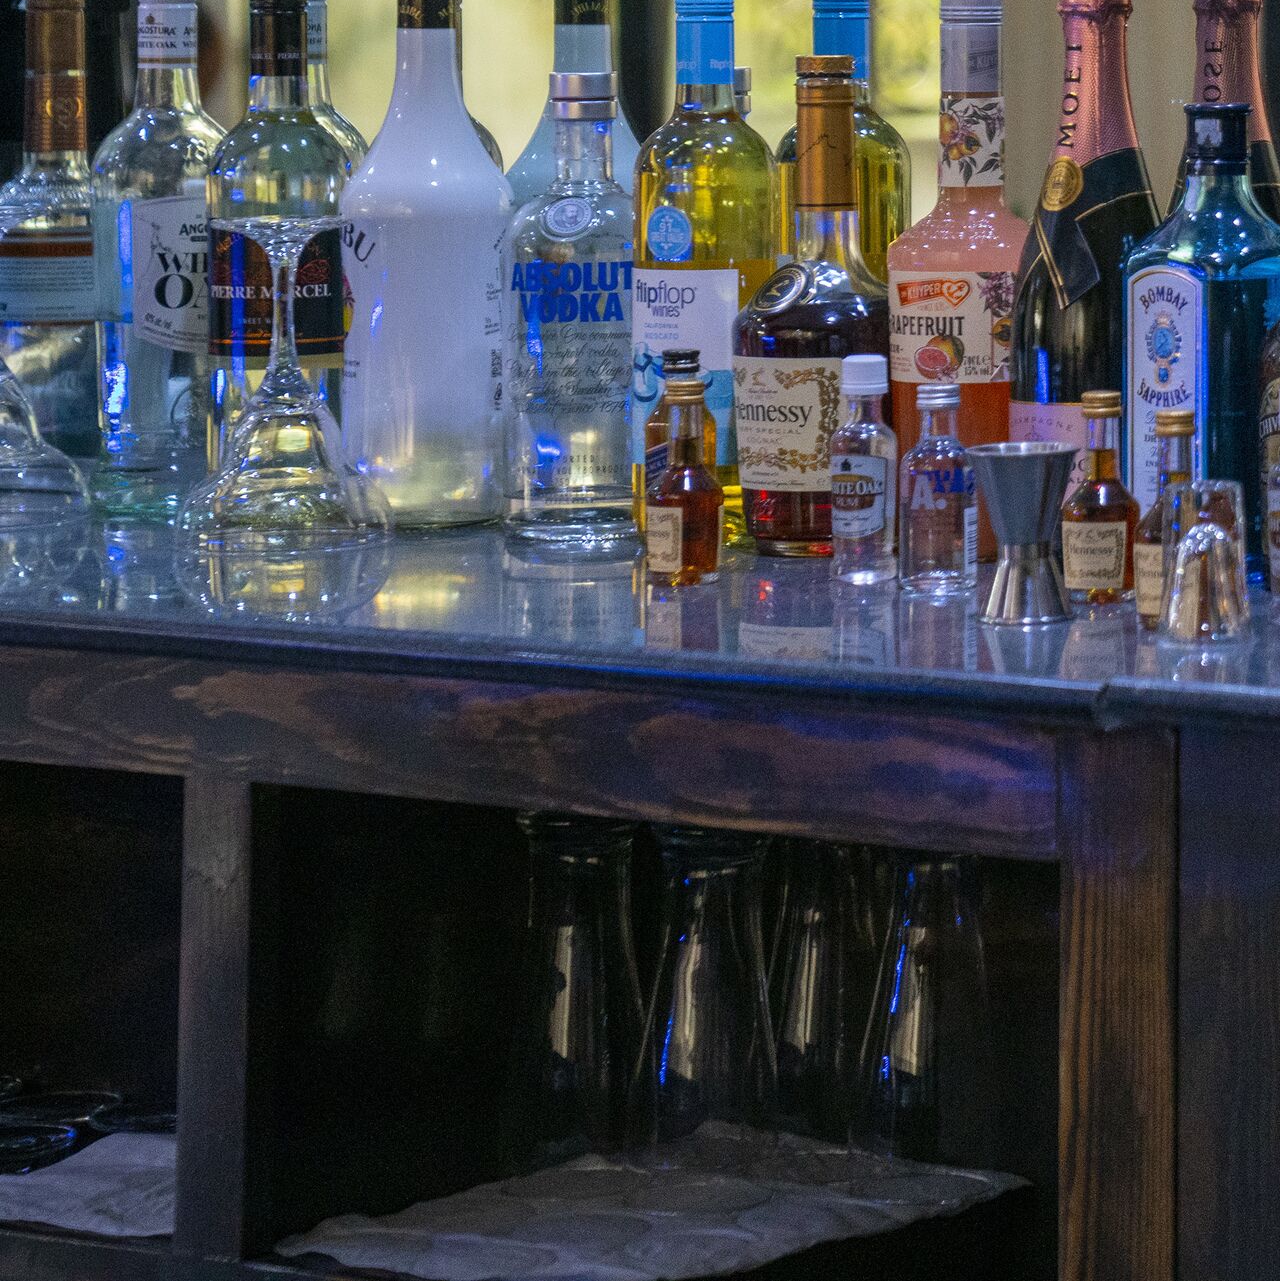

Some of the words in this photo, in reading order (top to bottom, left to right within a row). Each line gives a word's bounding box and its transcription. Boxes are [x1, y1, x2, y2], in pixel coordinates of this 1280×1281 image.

[511, 260, 634, 292] ABSOLUT
[211, 284, 255, 300] PIERRE
[260, 283, 332, 300] MRCEL
[636, 279, 696, 309] flipflop
[1139, 285, 1188, 313] BOMBAY
[520, 292, 624, 323] VODKA
[652, 304, 681, 318] wines
[889, 314, 965, 337] RAPEFRUIT
[1137, 384, 1192, 408] SAPPHIRE
[1258, 416, 1280, 438] CHIV
